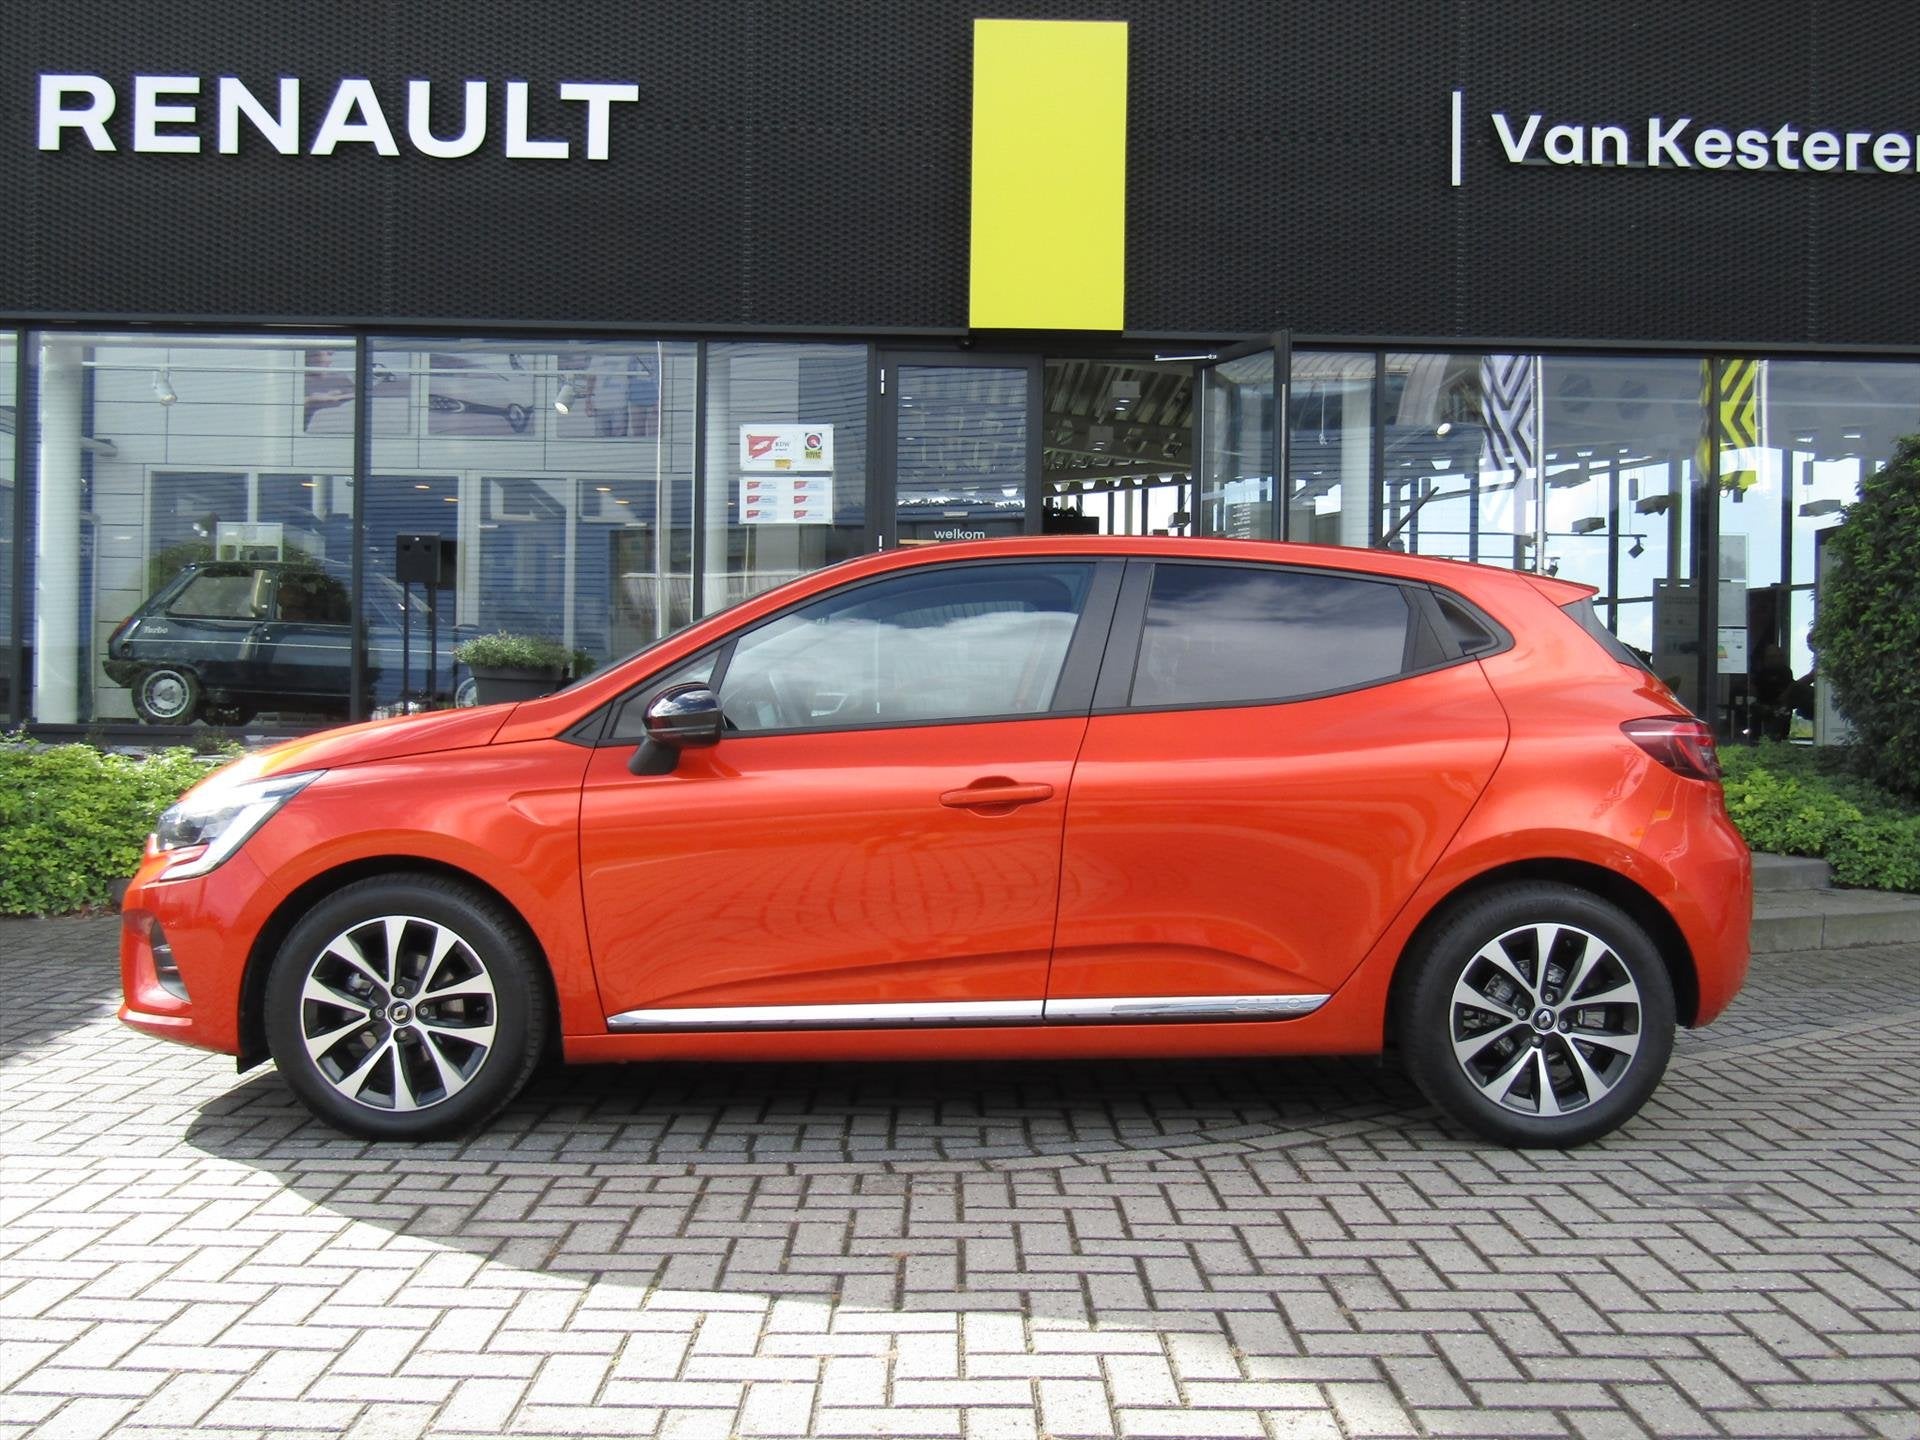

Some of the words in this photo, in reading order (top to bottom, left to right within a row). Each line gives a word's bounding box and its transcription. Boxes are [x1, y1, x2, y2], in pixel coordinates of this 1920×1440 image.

[38, 73, 640, 161] RENAULT
[1490, 113, 1629, 166] Van
[1647, 117, 1920, 173] Kestere
[934, 528, 985, 540] welkom
